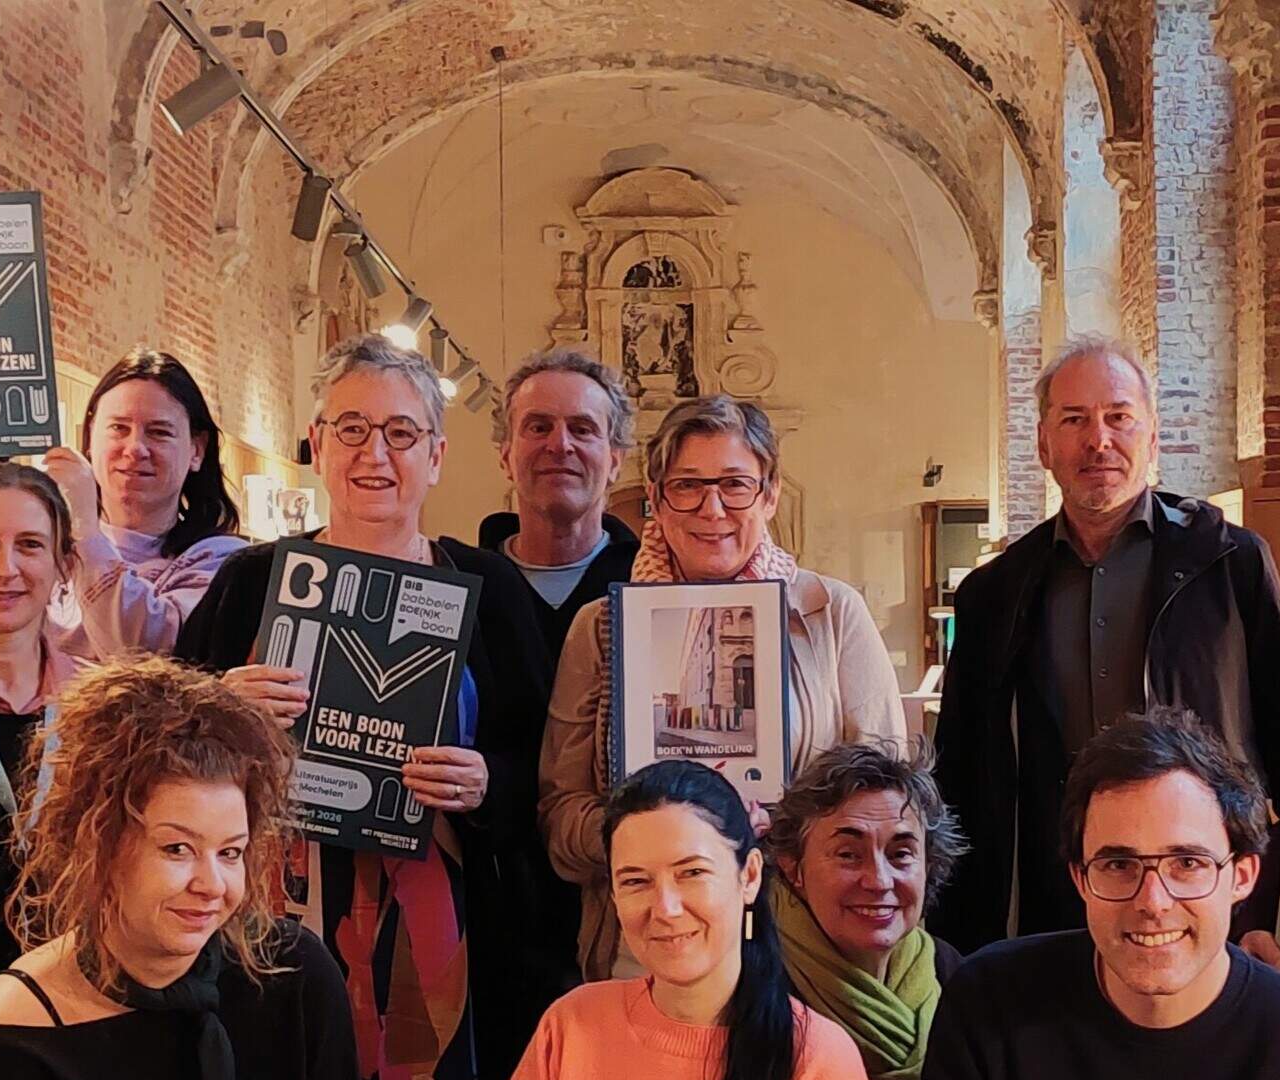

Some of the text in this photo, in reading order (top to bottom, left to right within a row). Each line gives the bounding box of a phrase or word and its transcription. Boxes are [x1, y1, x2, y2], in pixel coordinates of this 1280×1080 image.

[404, 580, 423, 591] BIB
[401, 592, 461, 612] babbelen
[399, 604, 441, 620] BOE(N)K
[421, 617, 454, 635] boon
[317, 707, 406, 741] EEN BOON
[315, 726, 360, 751] VOOR
[694, 744, 753, 755] WANDELING
